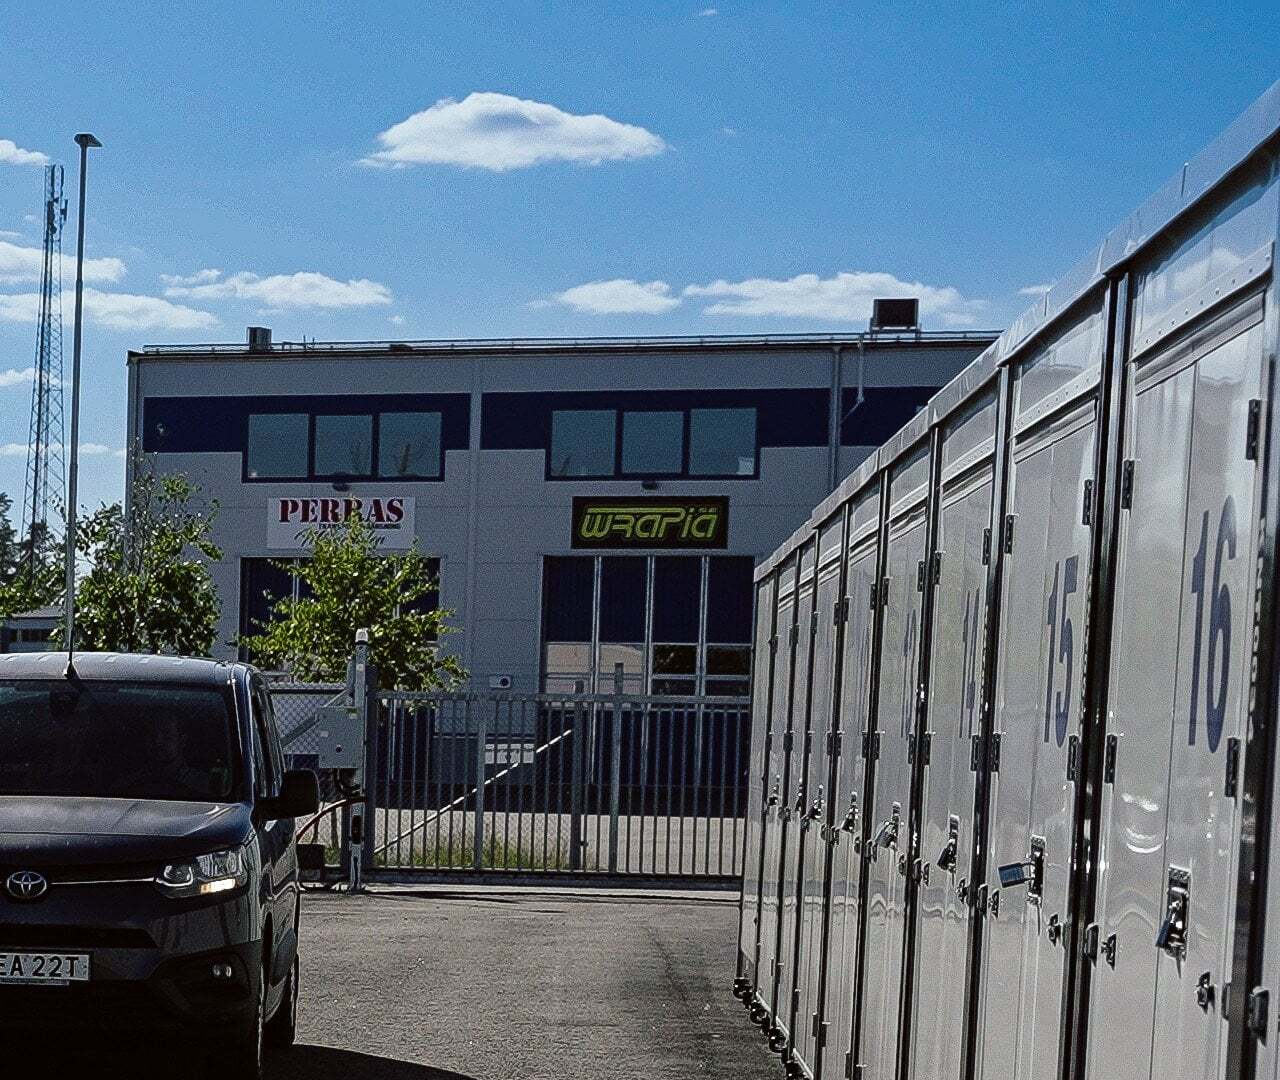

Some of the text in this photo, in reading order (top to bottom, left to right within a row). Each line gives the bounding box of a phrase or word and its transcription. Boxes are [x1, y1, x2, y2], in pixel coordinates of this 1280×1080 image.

[958, 587, 980, 739] 14
[1044, 555, 1079, 748] 15
[1188, 495, 1236, 753] 16
[32, 955, 79, 978] 22T
